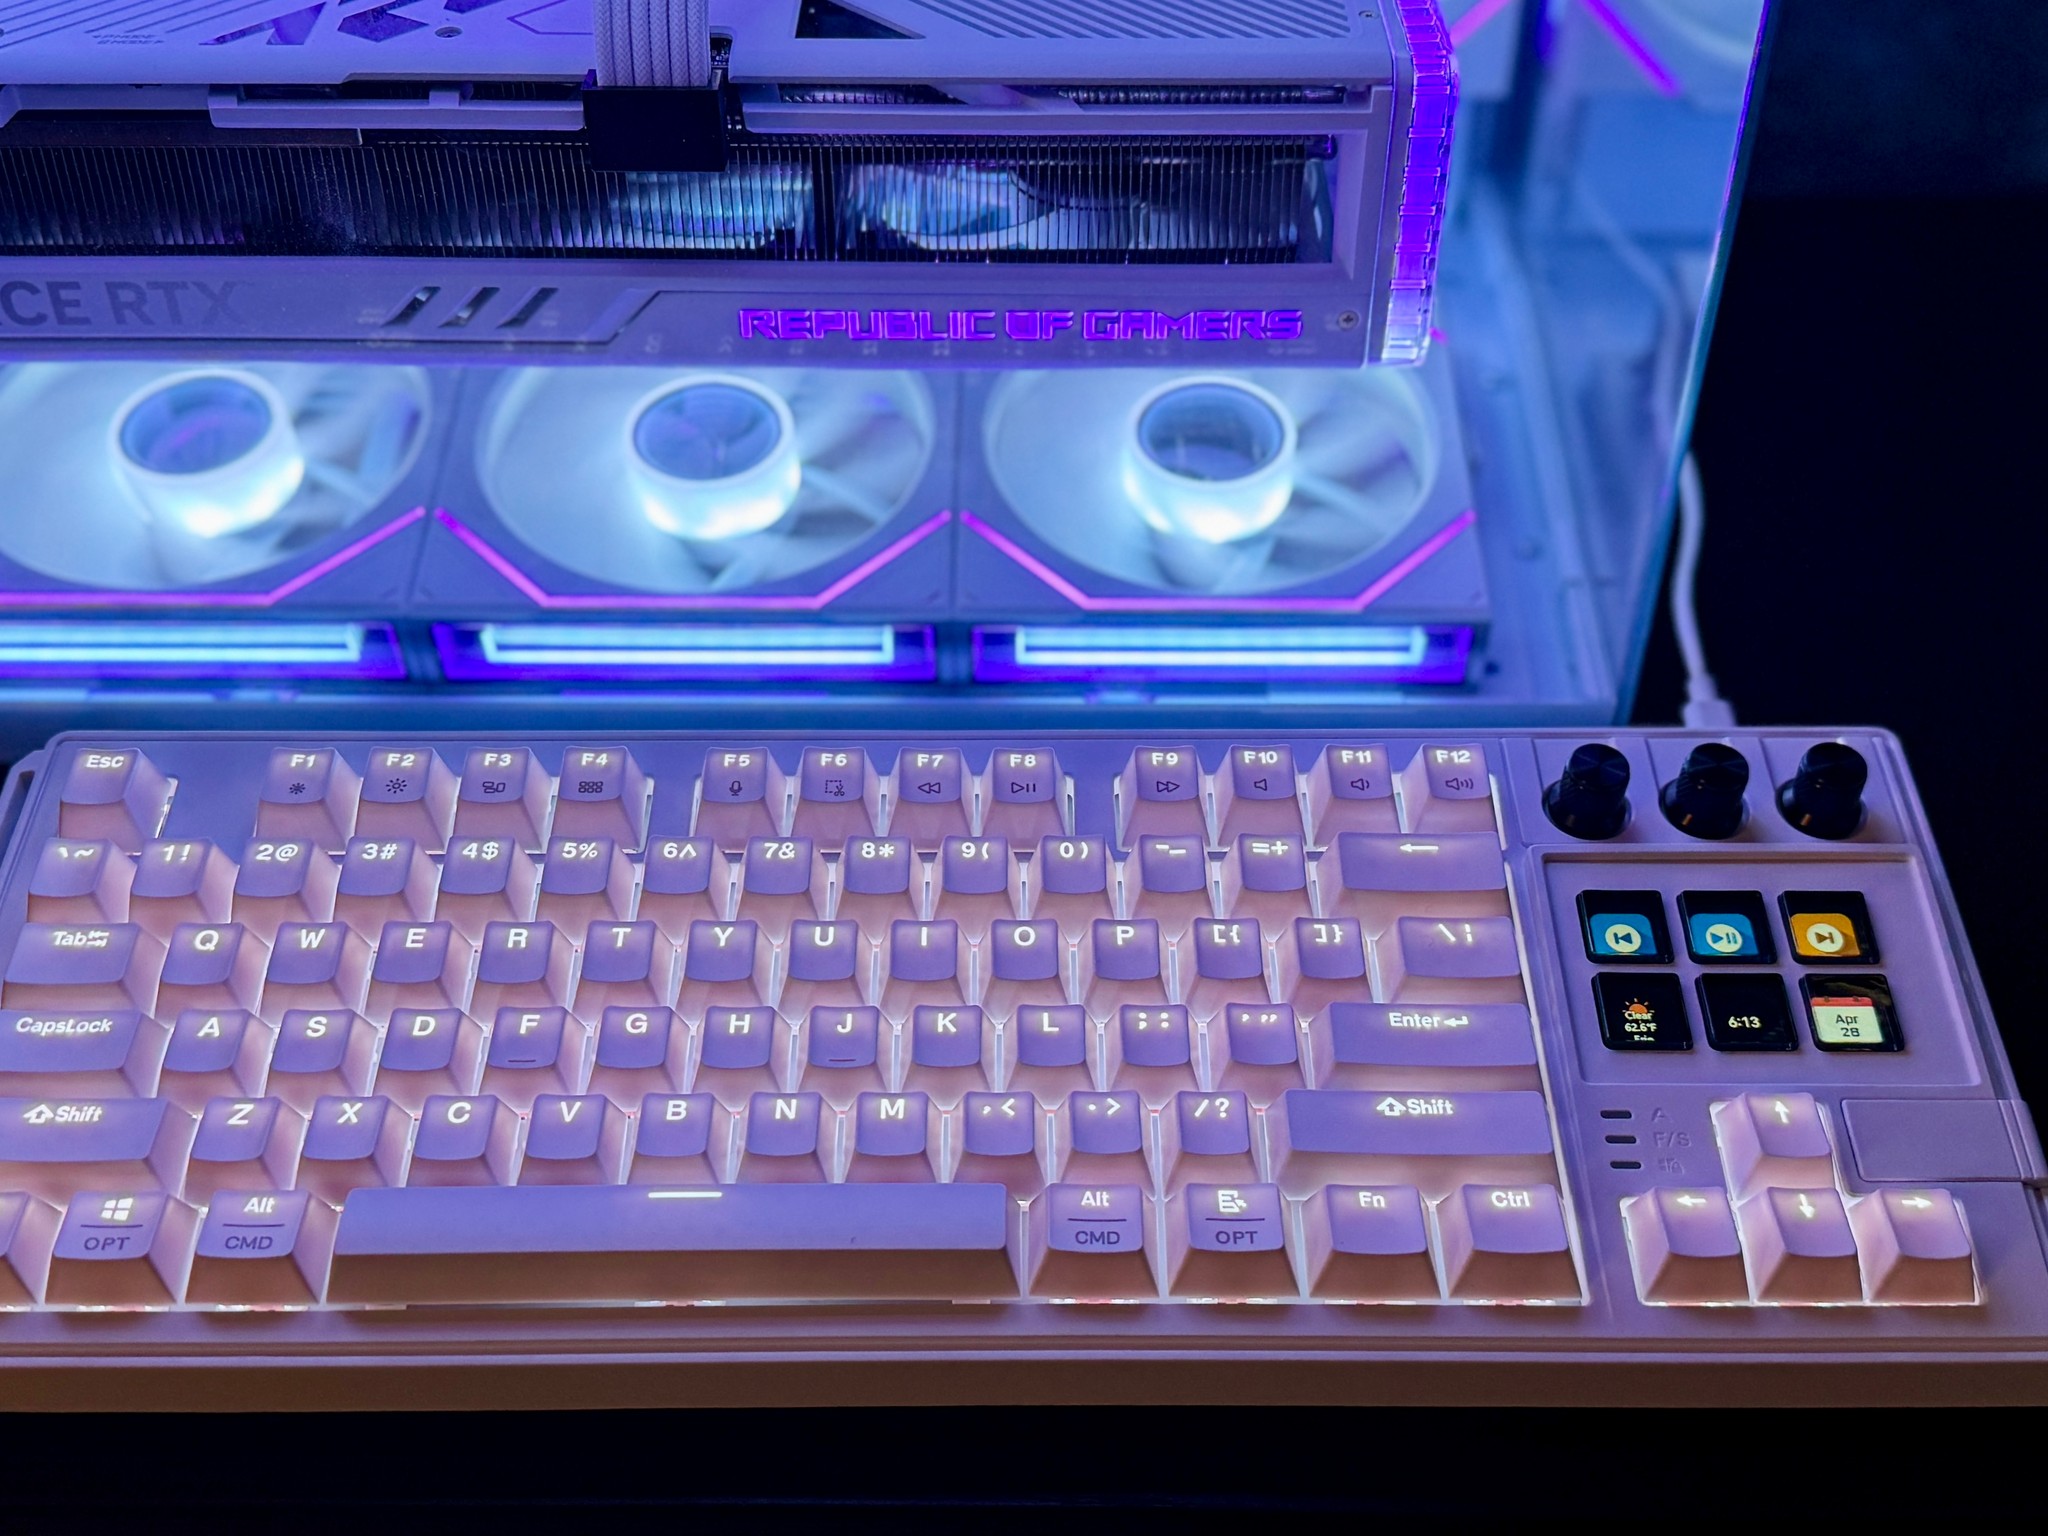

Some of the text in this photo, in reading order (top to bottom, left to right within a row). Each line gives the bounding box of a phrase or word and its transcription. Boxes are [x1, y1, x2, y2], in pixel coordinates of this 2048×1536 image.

[0, 281, 251, 326] CE RTX
[739, 308, 1303, 339] REPUBLIC OF GAMERS
[291, 755, 315, 767] F1
[387, 754, 415, 766] F2
[484, 754, 511, 766] F3
[582, 753, 607, 765] F4
[724, 754, 750, 766] F5
[821, 754, 847, 766] F6
[918, 754, 943, 767] F7
[1010, 754, 1036, 767] F8
[1152, 753, 1178, 765] F9
[1244, 751, 1278, 764] F10
[1342, 751, 1371, 763] F11
[1436, 750, 1470, 763] F12
[53, 931, 87, 948] Tab
[194, 930, 219, 950] Q
[301, 929, 325, 948] W
[406, 929, 426, 947] E
[508, 929, 528, 948] R
[612, 928, 631, 947] T
[713, 927, 733, 946] Y
[815, 927, 834, 946] U
[921, 927, 927, 946] I
[1014, 927, 1035, 946] O
[1117, 926, 1134, 945] P
[626, 1014, 647, 1033] G
[729, 1014, 750, 1033] H
[837, 1014, 852, 1033] J
[938, 1013, 956, 1032] K
[1043, 1013, 1059, 1031] L
[1389, 1013, 1441, 1029] Enter
[1624, 1010, 1653, 1021] Clear
[1729, 1017, 1760, 1028] 6:13
[1836, 1013, 1860, 1026] Apr
[16, 1018, 112, 1034] CapsLock
[198, 1017, 219, 1037] A
[306, 1017, 327, 1037] S
[413, 1016, 435, 1035] D
[520, 1015, 540, 1034] F
[1841, 1027, 1860, 1038] 28
[55, 1106, 102, 1122] Shift
[228, 1104, 254, 1124] Z
[338, 1103, 362, 1123] X
[448, 1102, 471, 1123] C
[561, 1102, 581, 1122] V
[666, 1100, 687, 1120] B
[775, 1099, 797, 1119] N
[881, 1099, 905, 1119] M
[1407, 1099, 1453, 1114] Shift
[1653, 1131, 1692, 1148] F/S
[244, 1198, 275, 1213] Alt
[1081, 1191, 1109, 1206] Alt
[1359, 1192, 1385, 1207] Fn
[1491, 1192, 1530, 1207] Ctrl
[83, 1236, 130, 1252] OPT
[225, 1235, 273, 1251] CMD
[1075, 1230, 1121, 1246] CMD
[1215, 1230, 1258, 1245] OPT
